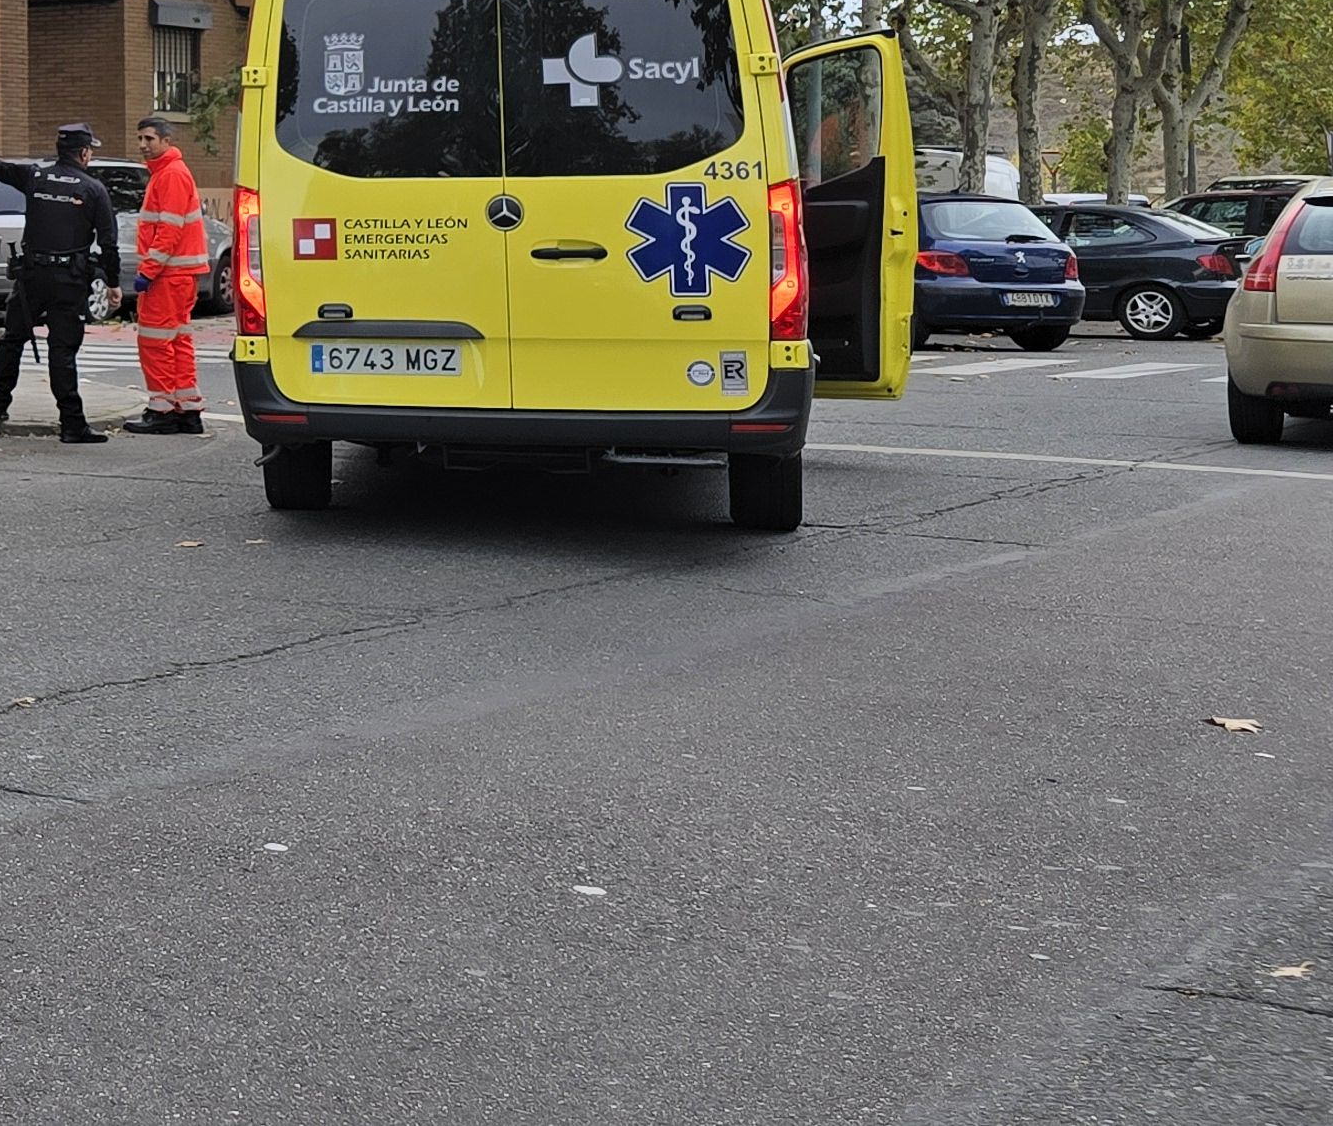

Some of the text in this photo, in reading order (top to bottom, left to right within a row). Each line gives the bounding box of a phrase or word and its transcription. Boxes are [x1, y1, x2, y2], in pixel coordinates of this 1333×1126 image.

[629, 57, 700, 84] Sacyl
[367, 76, 459, 94] Junta de
[313, 95, 459, 117] Castilla y León
[704, 161, 763, 180] 4361
[344, 216, 468, 229] CASTILLA Y LEÓN
[344, 234, 449, 245] EMERGENCIAS
[344, 249, 431, 260] SANITARIAS
[329, 348, 457, 371] 6743 MGZ
[722, 360, 745, 380] ER
